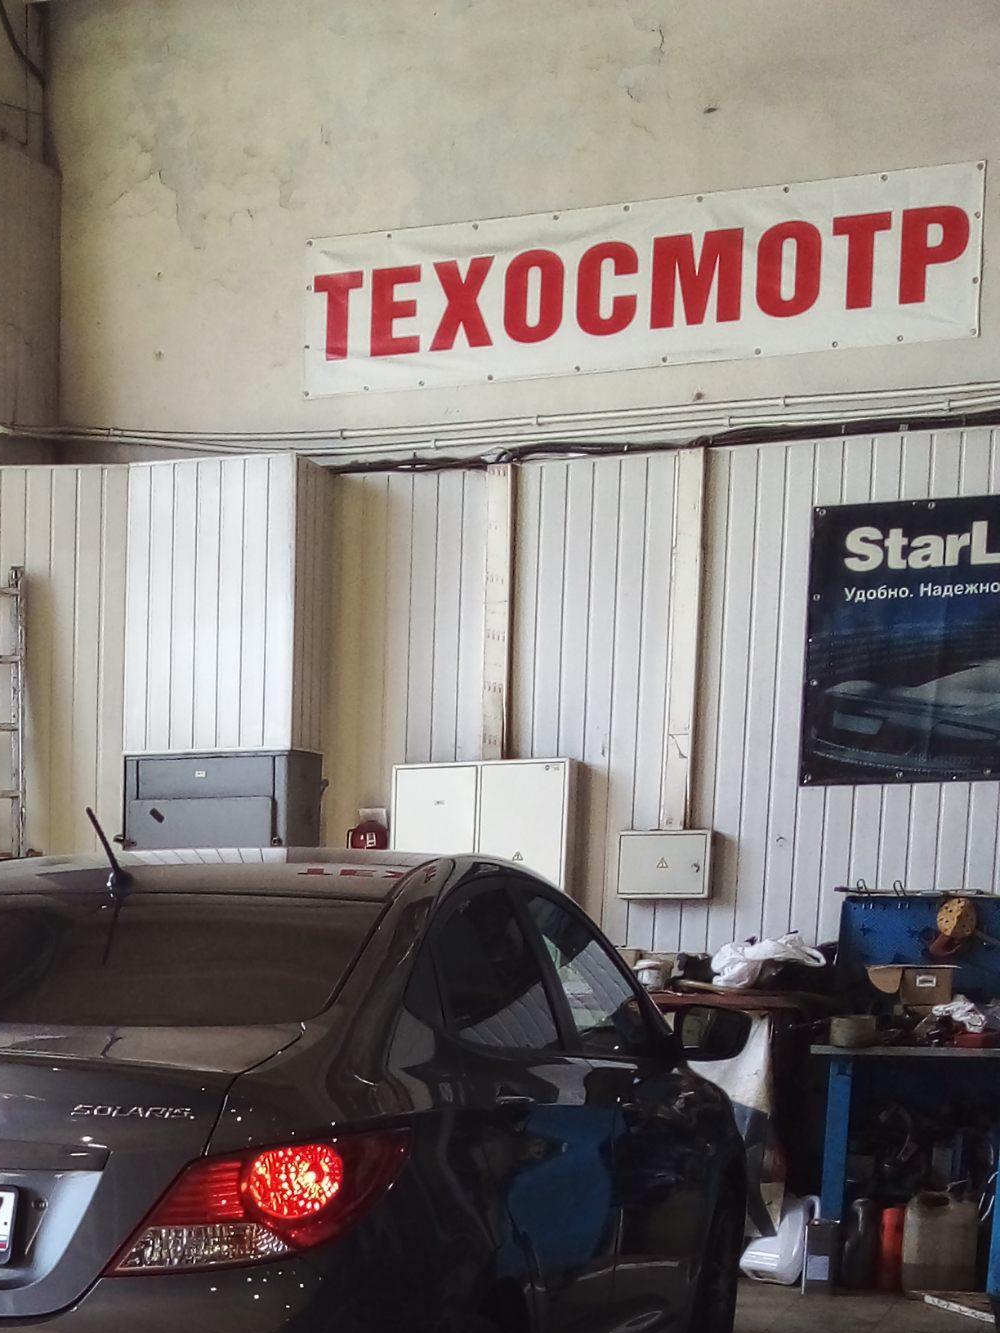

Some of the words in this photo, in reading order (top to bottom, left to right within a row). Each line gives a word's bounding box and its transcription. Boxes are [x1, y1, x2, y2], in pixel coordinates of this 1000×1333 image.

[313, 205, 970, 361] ТЕХОСМОТР
[844, 520, 1000, 572] StarL
[844, 584, 914, 603] Удобно.
[919, 581, 1000, 599] Надежно
[70, 1104, 191, 1118] SOLARIS
